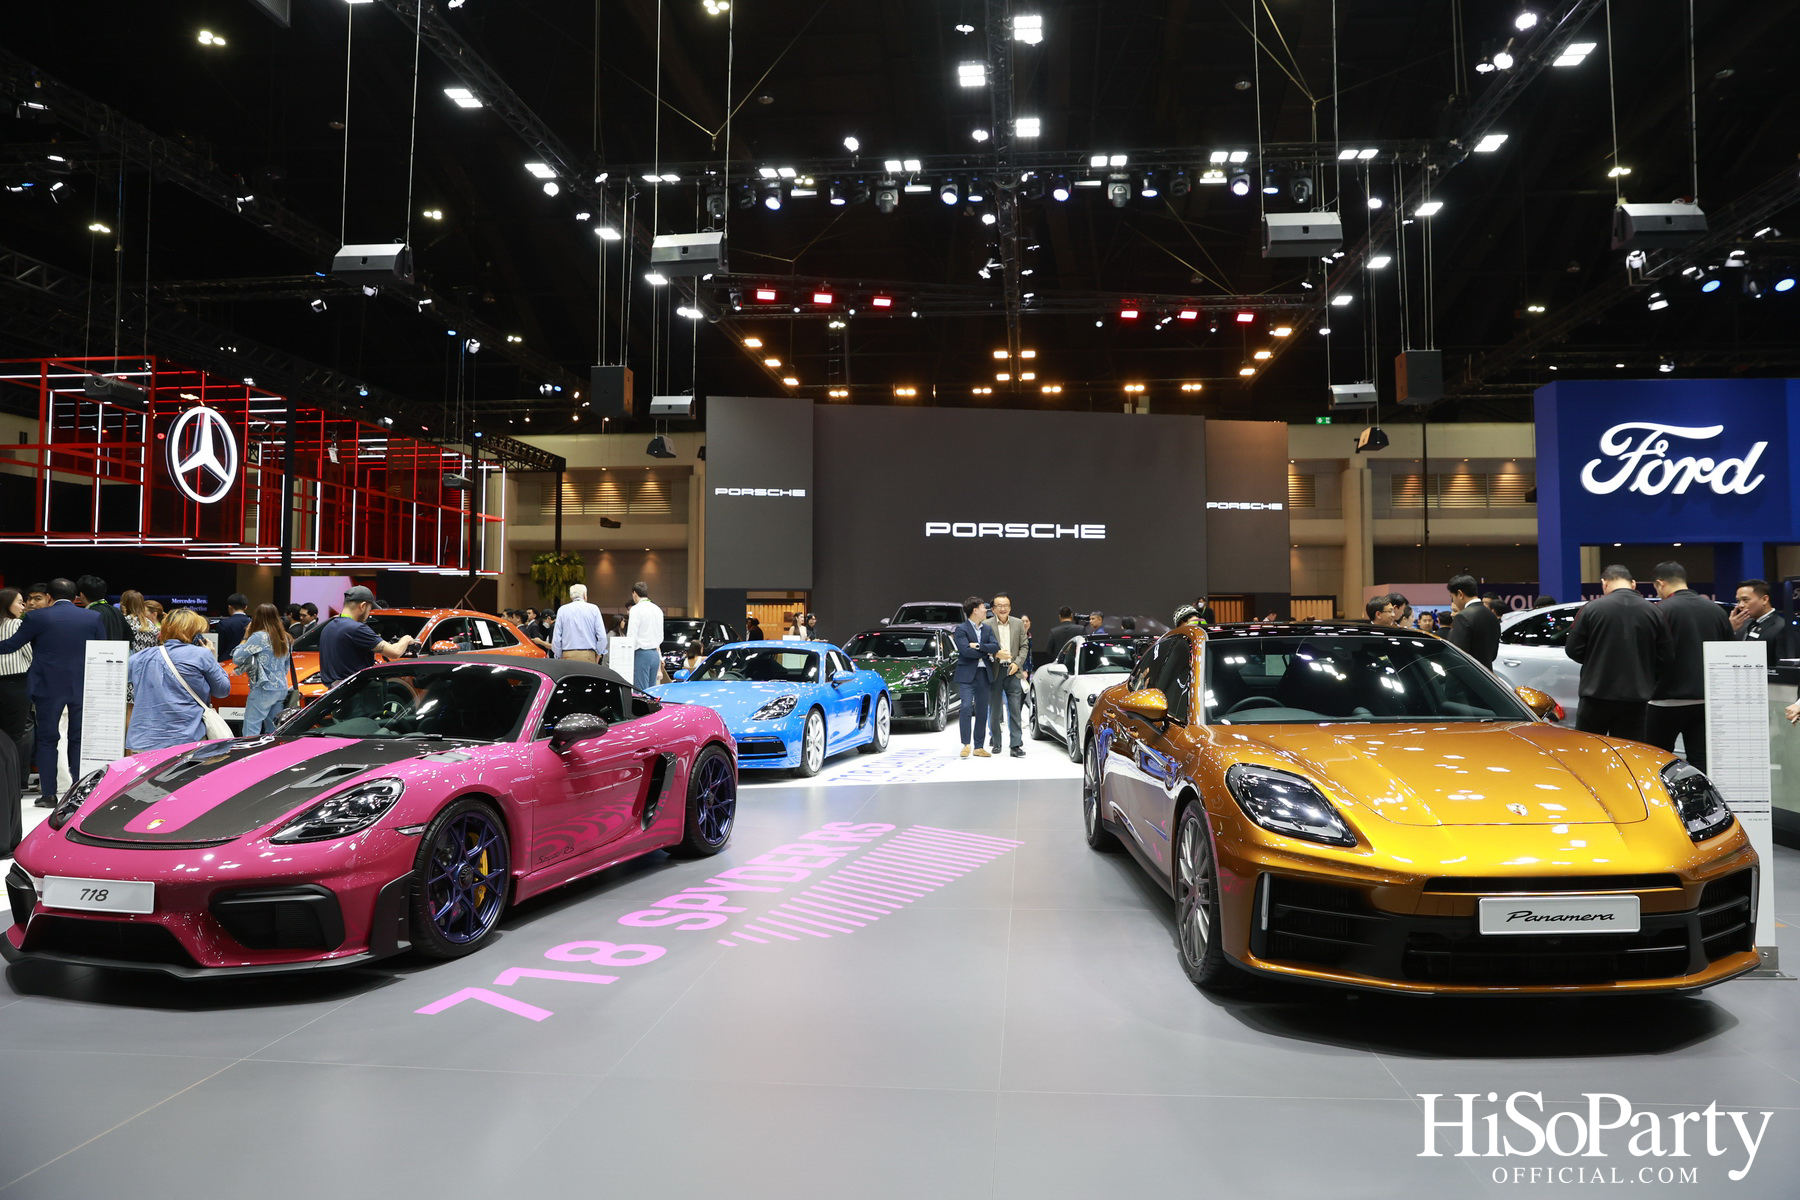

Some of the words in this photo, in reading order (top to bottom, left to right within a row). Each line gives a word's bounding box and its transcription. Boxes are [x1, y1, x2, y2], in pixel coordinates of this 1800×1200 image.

[1580, 421, 1769, 496] Ford
[715, 488, 806, 497] PORSCHE
[1206, 502, 1283, 510] PORSCHE
[925, 522, 1106, 539] PORSCHE
[80, 888, 109, 902] 718
[414, 940, 667, 1022] 718
[618, 843, 860, 931] SPYDER
[799, 821, 897, 843] RS
[1506, 910, 1615, 923] Panamera
